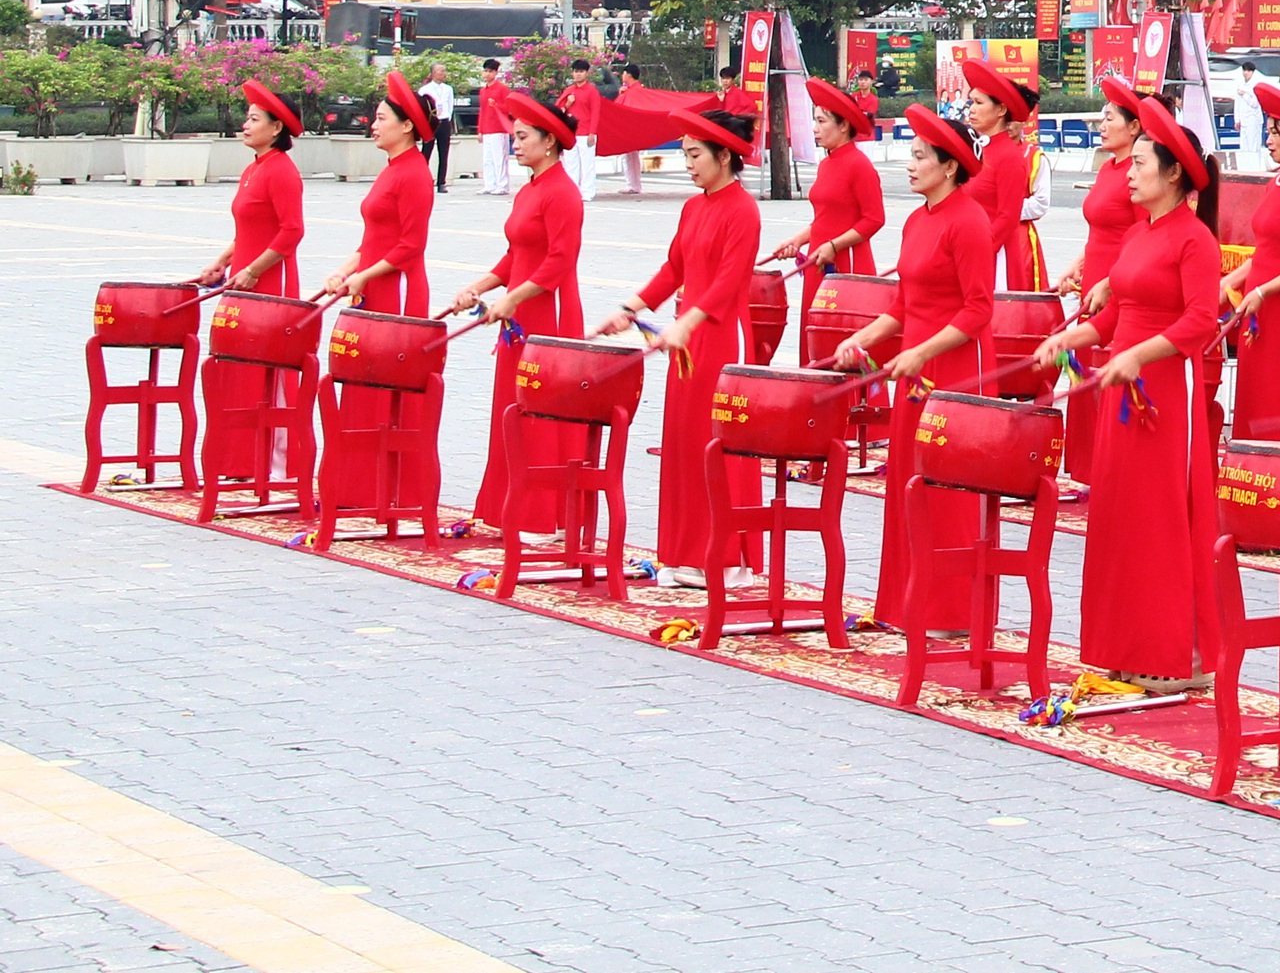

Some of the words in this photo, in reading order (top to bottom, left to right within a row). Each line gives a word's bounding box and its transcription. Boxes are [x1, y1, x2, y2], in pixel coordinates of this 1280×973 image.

[1259, 3, 1271, 14] DÂN
[1257, 19, 1265, 31] KỶ
[1260, 36, 1270, 47] ĐỔI
[345, 332, 359, 345] HỘI
[526, 362, 540, 376] HỘI
[731, 394, 748, 410] HỘI
[931, 414, 947, 430] HỘI
[1225, 462, 1252, 483] TRỐNG
[1253, 472, 1277, 491] HỘI
[1232, 487, 1258, 506] THẠCH
